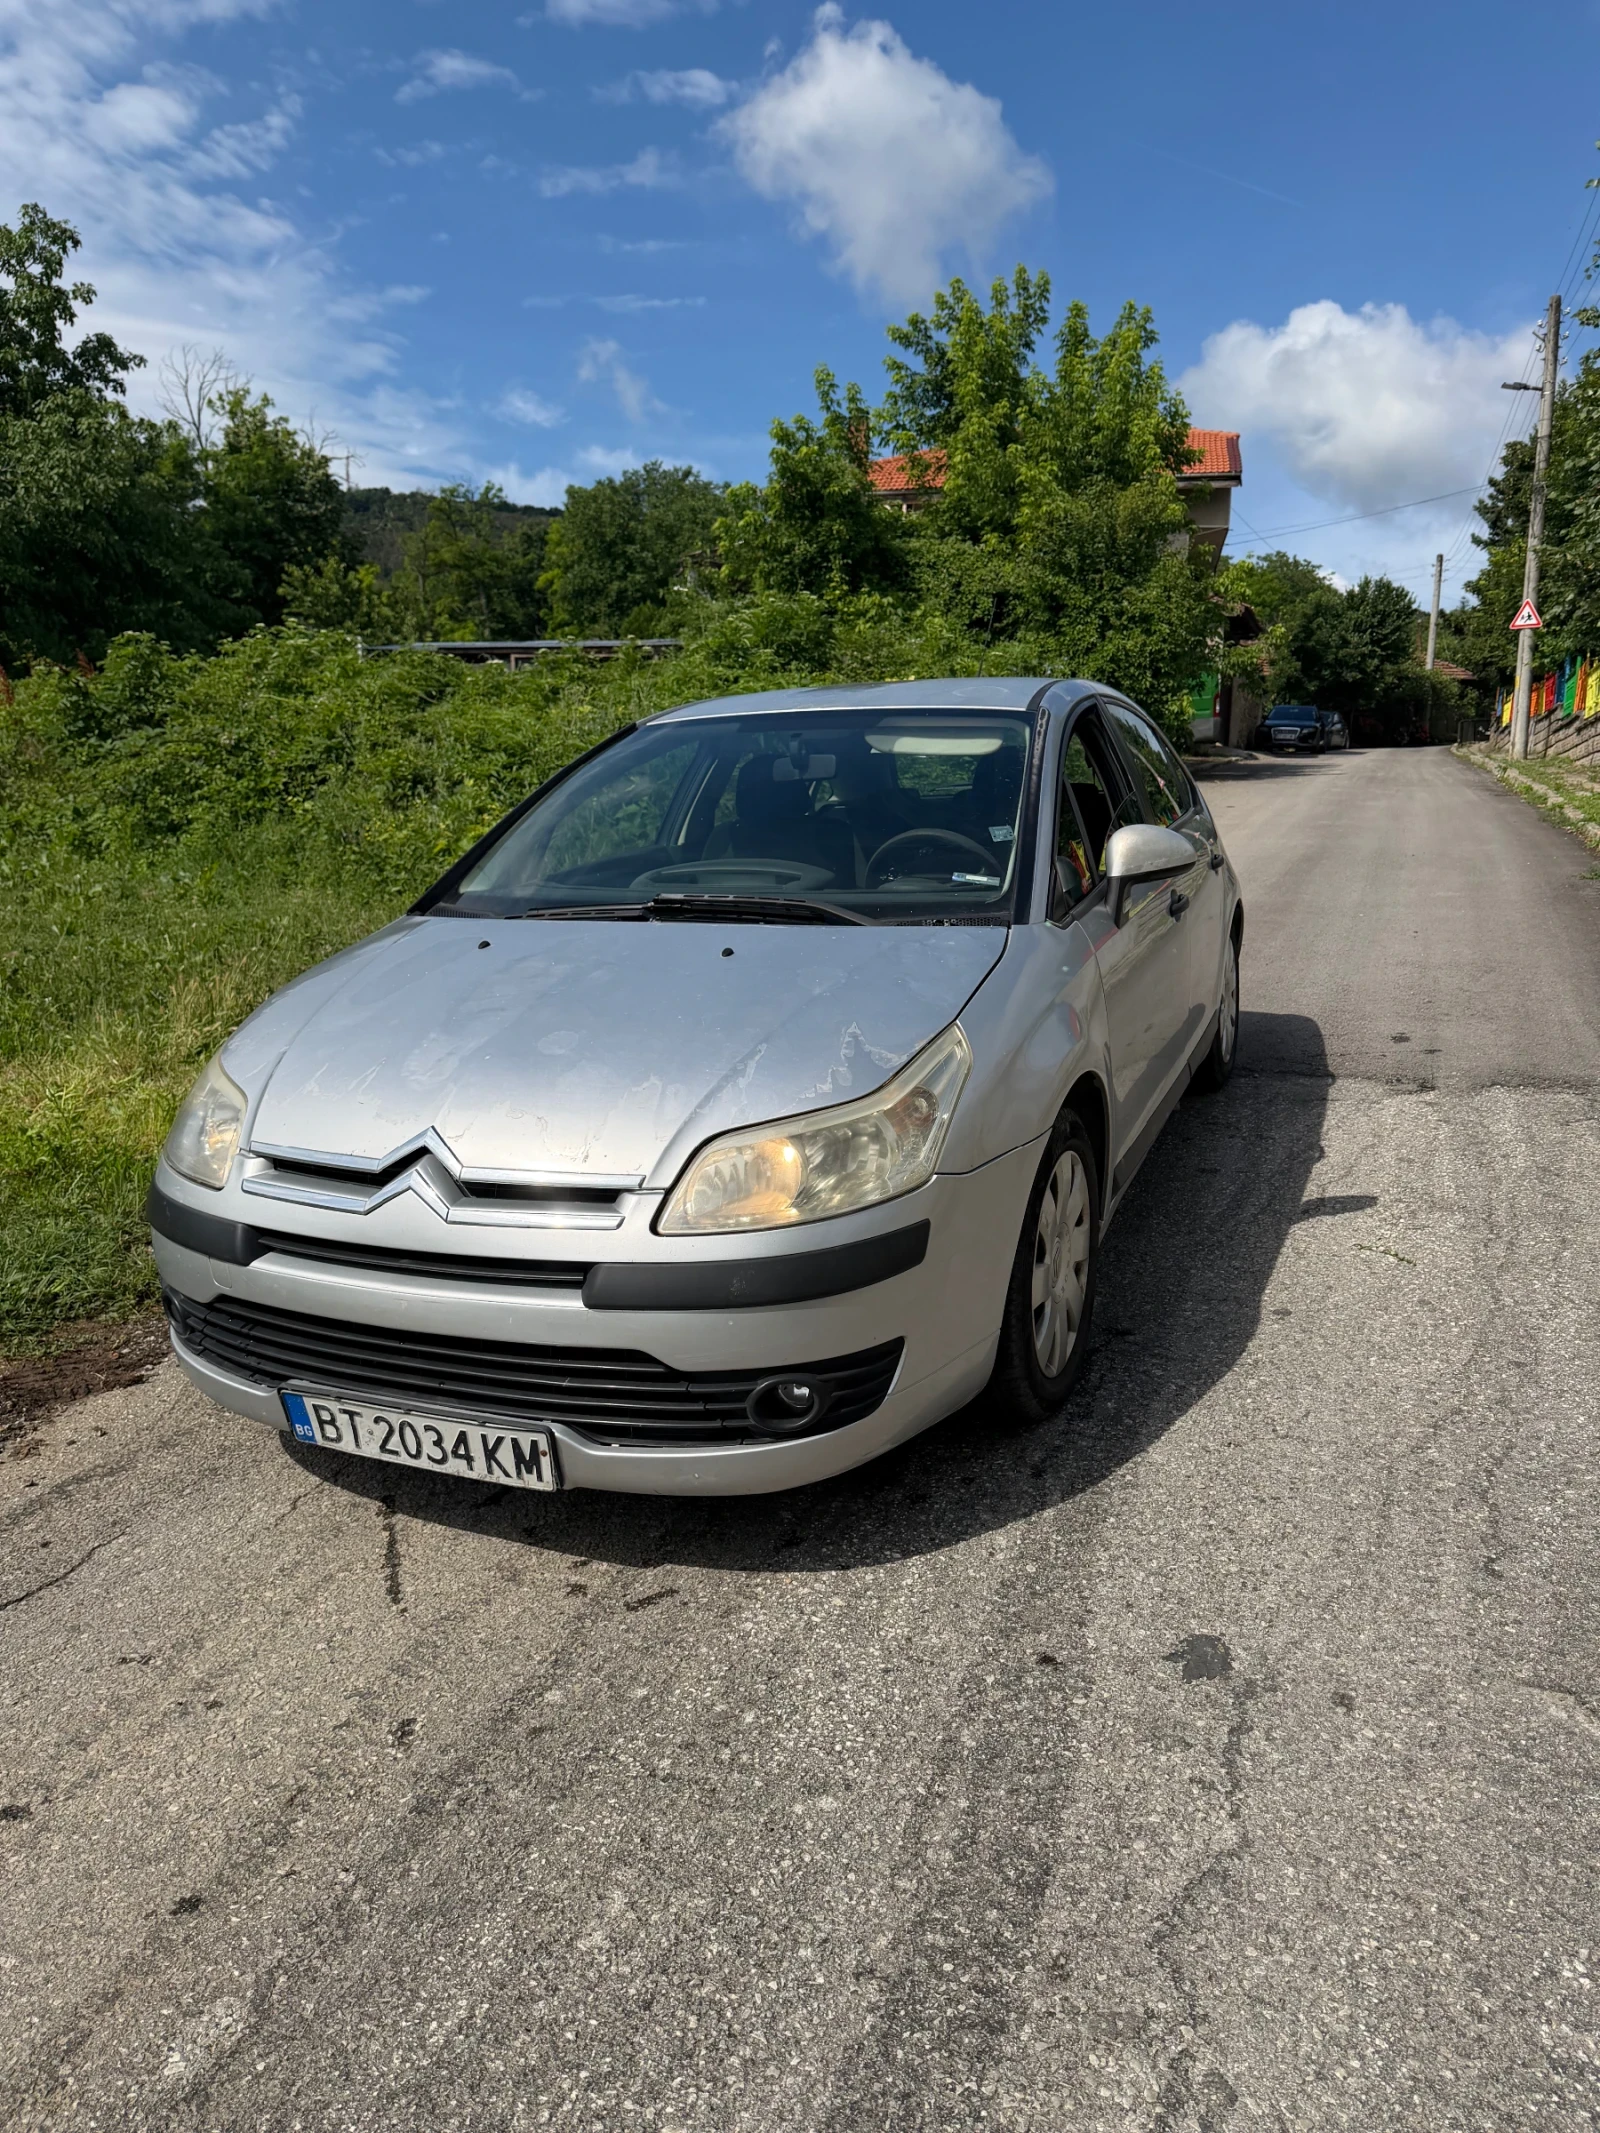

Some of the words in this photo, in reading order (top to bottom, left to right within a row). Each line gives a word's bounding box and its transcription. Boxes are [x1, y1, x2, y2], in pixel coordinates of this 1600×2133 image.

[295, 1423, 313, 1437] BG
[311, 1403, 362, 1449] BT
[373, 1415, 475, 1471] 2034
[480, 1433, 544, 1482] KM
